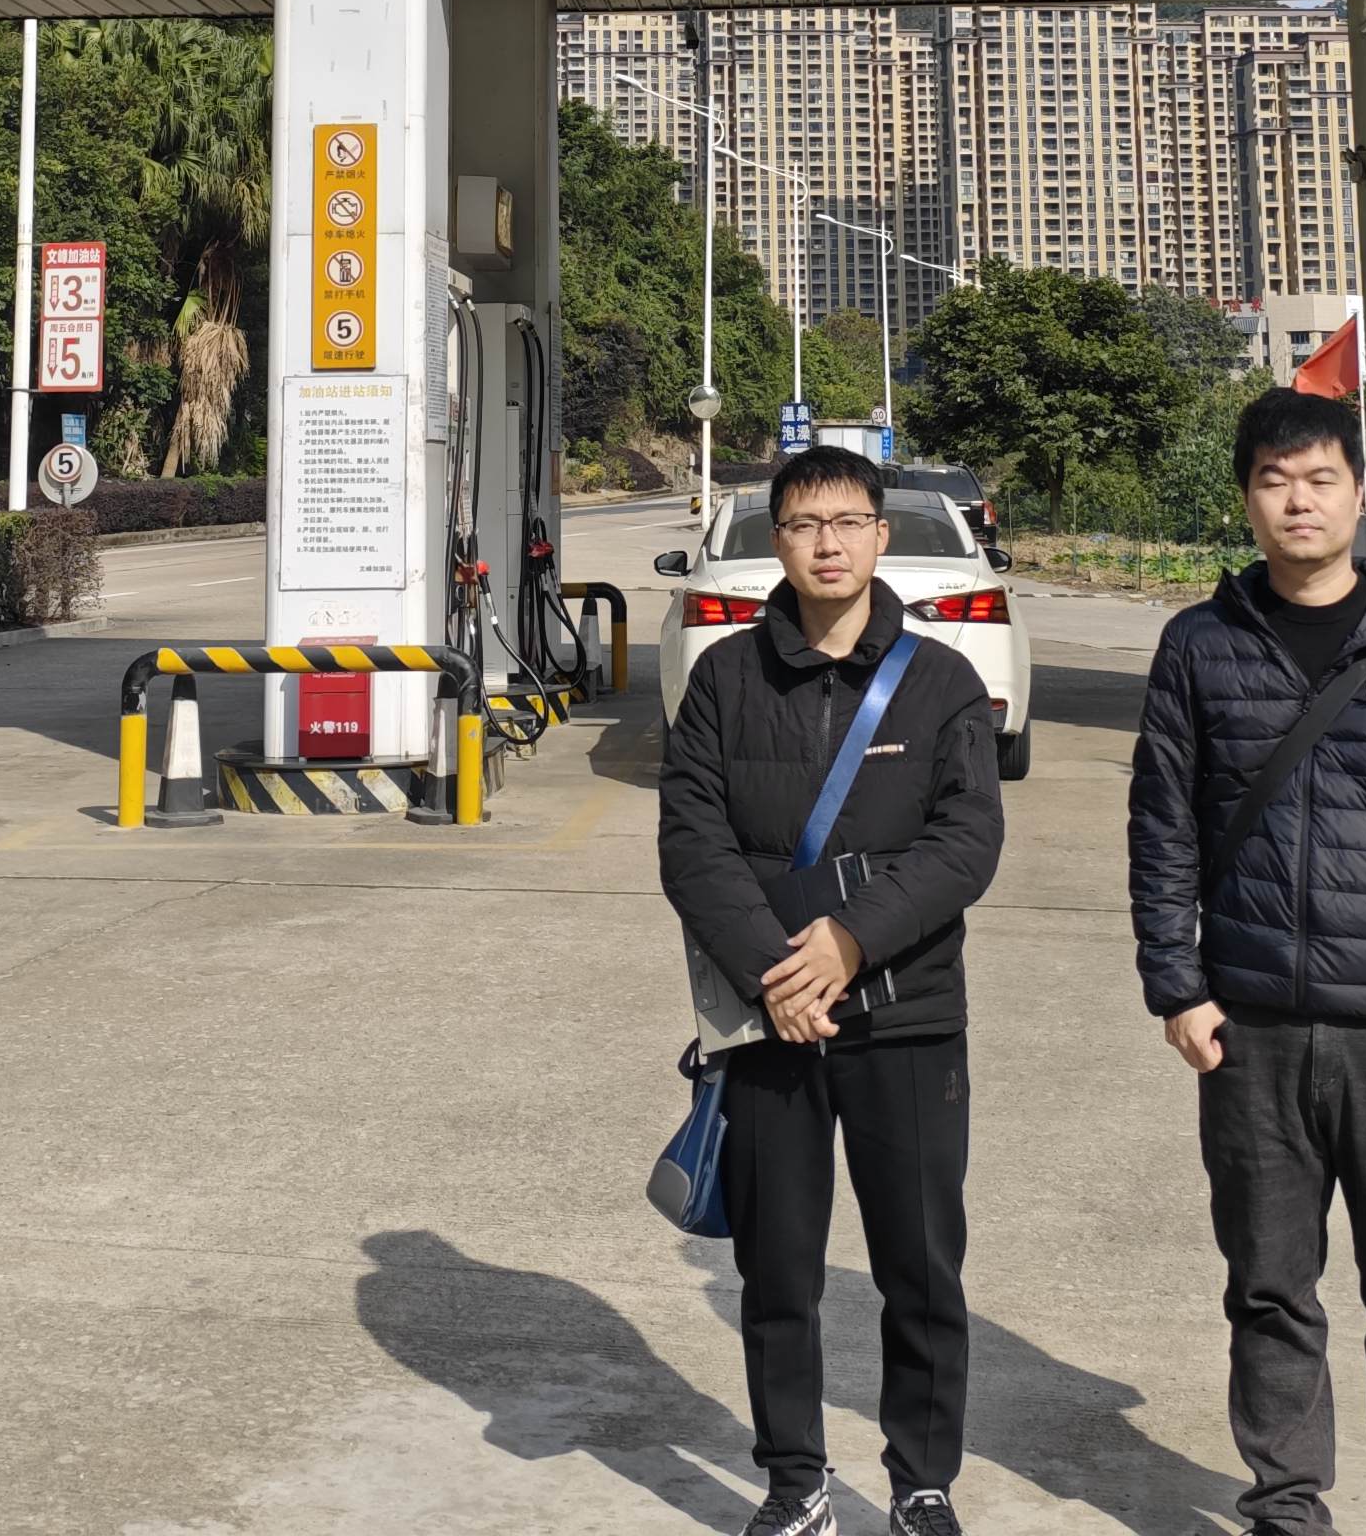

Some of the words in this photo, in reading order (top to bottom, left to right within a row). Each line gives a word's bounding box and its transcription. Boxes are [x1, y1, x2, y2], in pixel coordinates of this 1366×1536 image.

[324, 170, 366, 180] 严禁烟火
[324, 229, 366, 239] 停车熄火
[46, 249, 100, 264] 文峰加油站
[62, 275, 82, 311] 3
[50, 323, 93, 333] 周五会员日
[337, 319, 352, 339] 5
[60, 337, 80, 380] 5
[781, 406, 810, 422] 温泉
[781, 424, 810, 441] 泡澡
[58, 452, 73, 475] 5
[310, 720, 359, 735] 火警119
